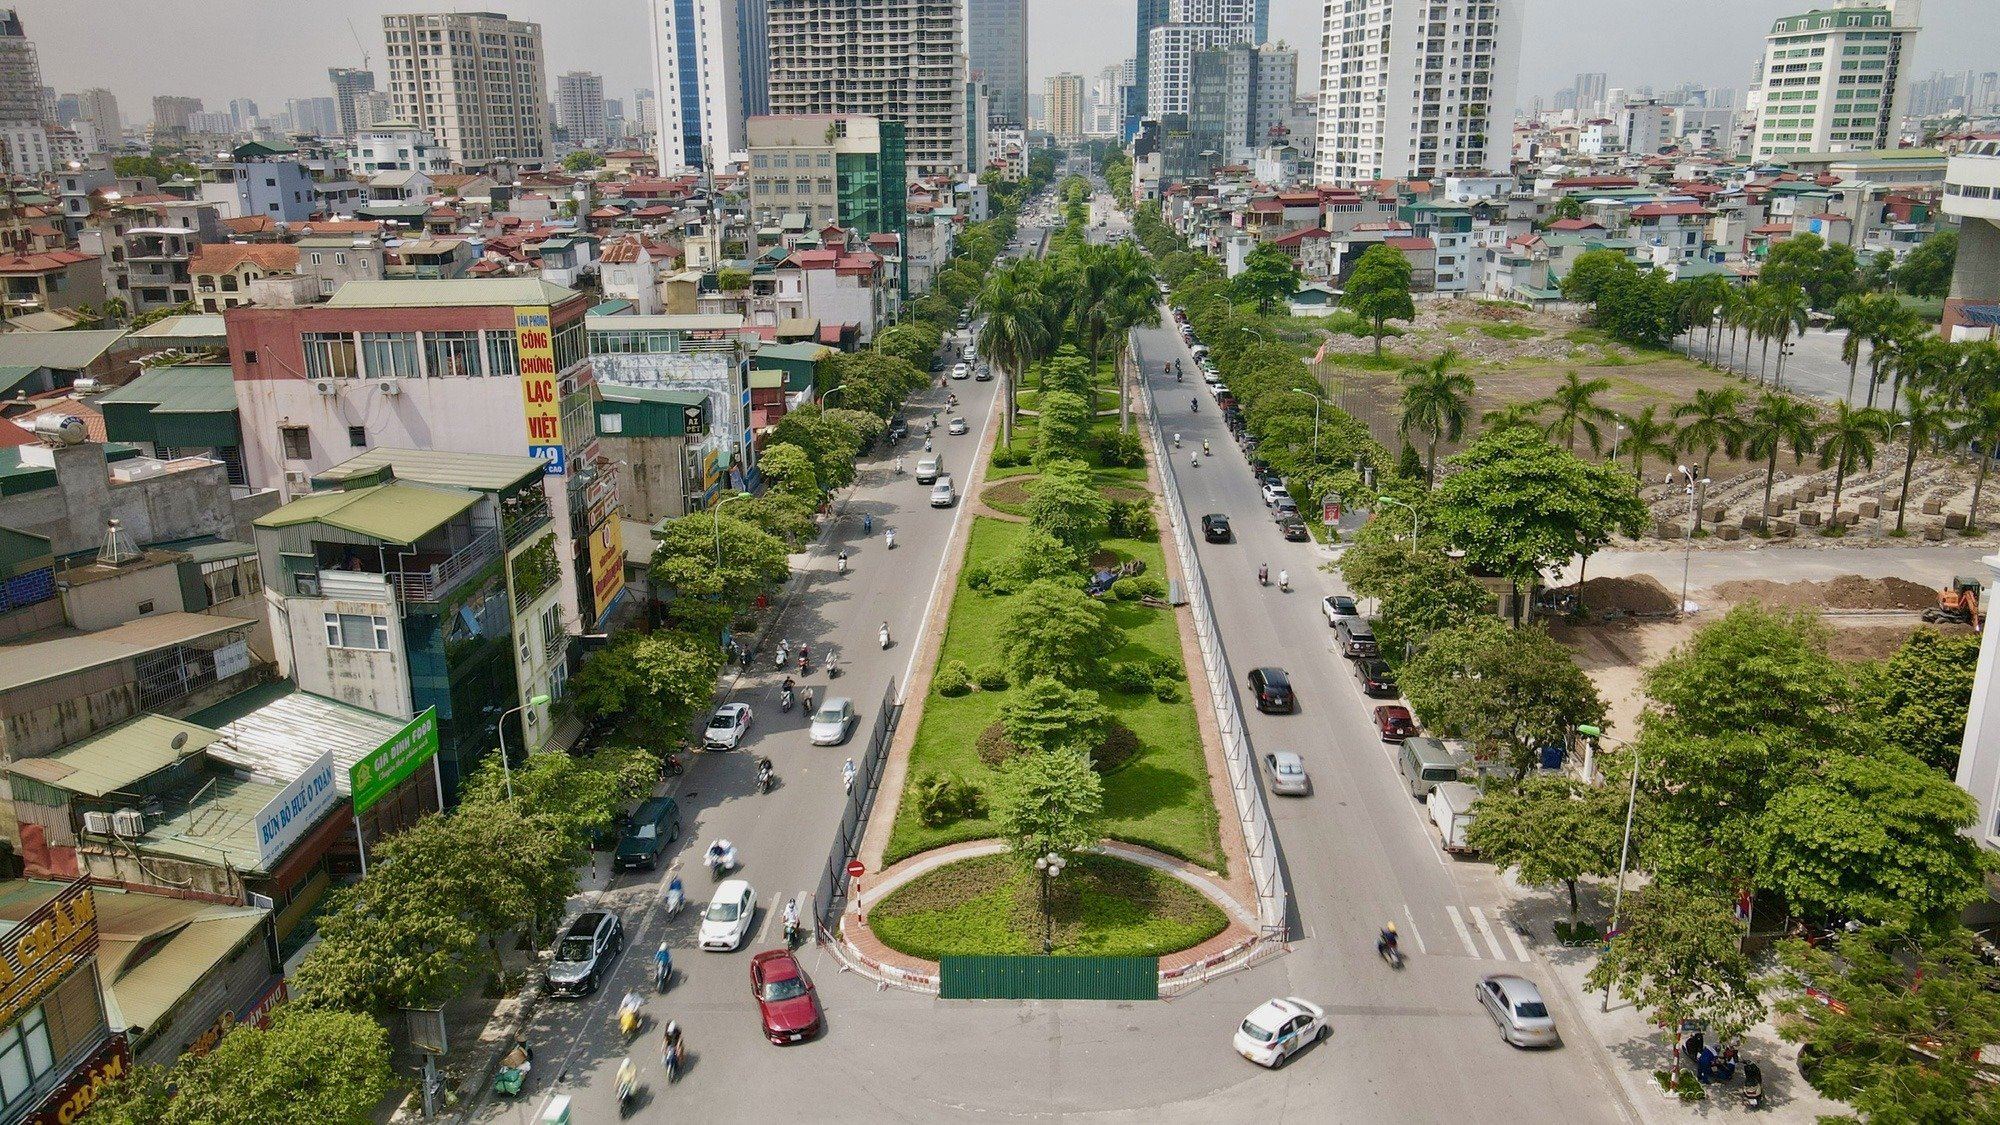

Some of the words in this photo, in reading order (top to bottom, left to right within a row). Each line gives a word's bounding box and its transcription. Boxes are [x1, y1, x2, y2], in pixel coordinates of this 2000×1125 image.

[521, 329, 548, 349] CÔNG
[521, 354, 553, 373] CHỨNG
[526, 380, 553, 407] LẠC
[528, 412, 557, 443] VIỆT
[374, 752, 389, 772] GIA
[391, 736, 410, 759] ĐÌNH
[412, 719, 432, 743] FOOD
[262, 815, 280, 845] BÚN
[280, 801, 291, 828] BÒ
[291, 781, 308, 817] HUẾ
[307, 784, 314, 803] O
[313, 765, 332, 797] TOÀN
